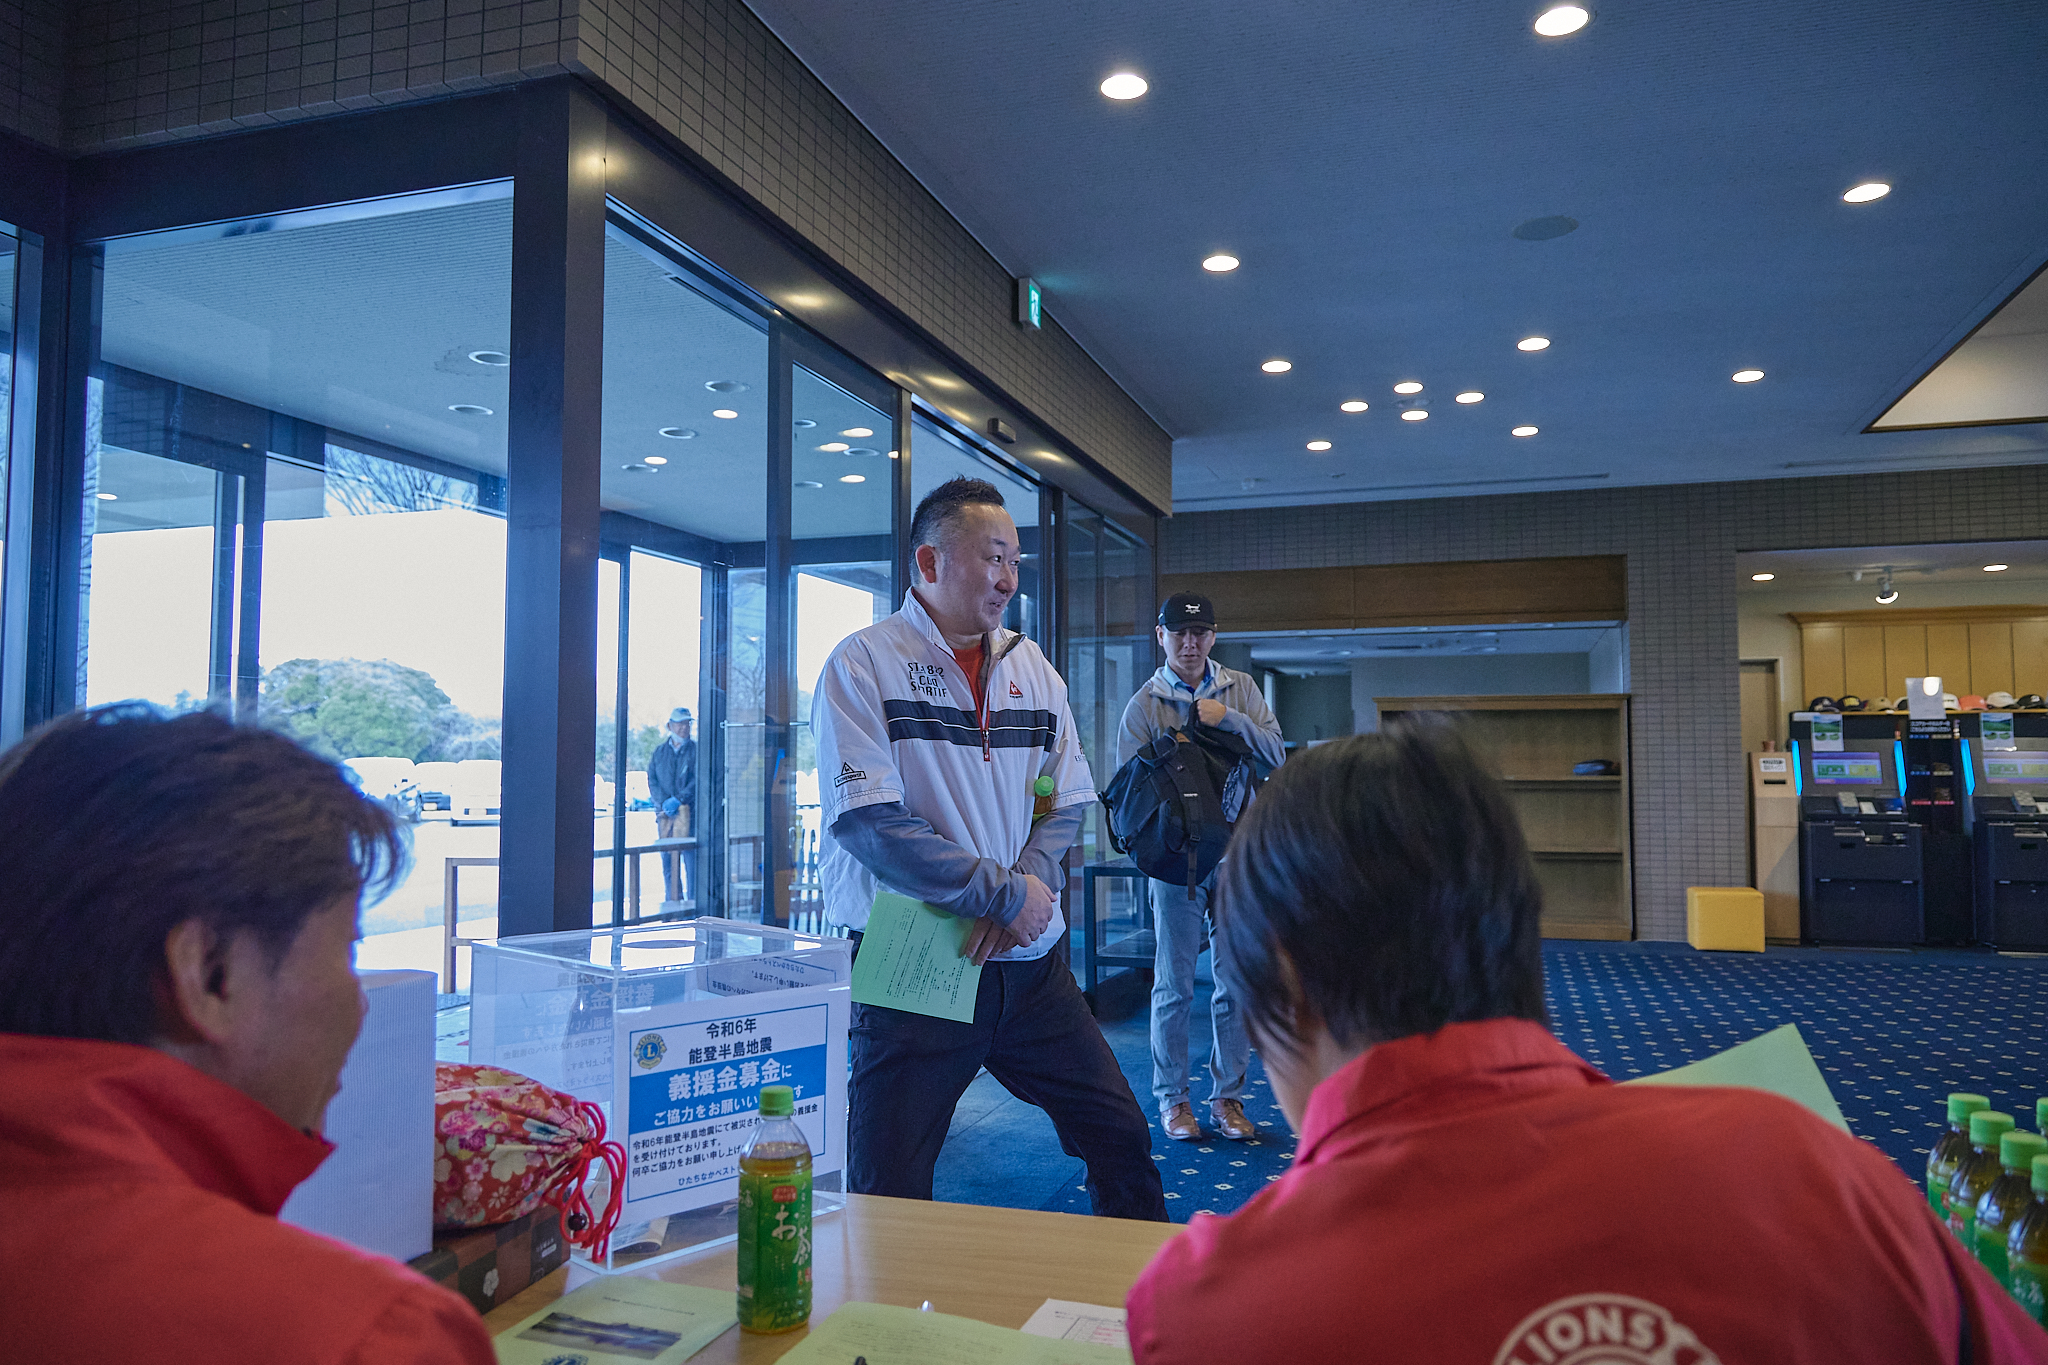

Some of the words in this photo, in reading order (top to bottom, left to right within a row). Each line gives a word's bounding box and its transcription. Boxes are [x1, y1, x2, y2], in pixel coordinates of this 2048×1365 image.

[706, 1018, 757, 1039] 令和6年
[688, 1036, 772, 1065] 能登半島地震
[668, 1057, 792, 1101] 義援金募金に
[653, 1084, 804, 1127] ご協力をお願いいす
[633, 1138, 721, 1164] を受け付けております。
[1510, 1305, 1656, 1365] IONS
